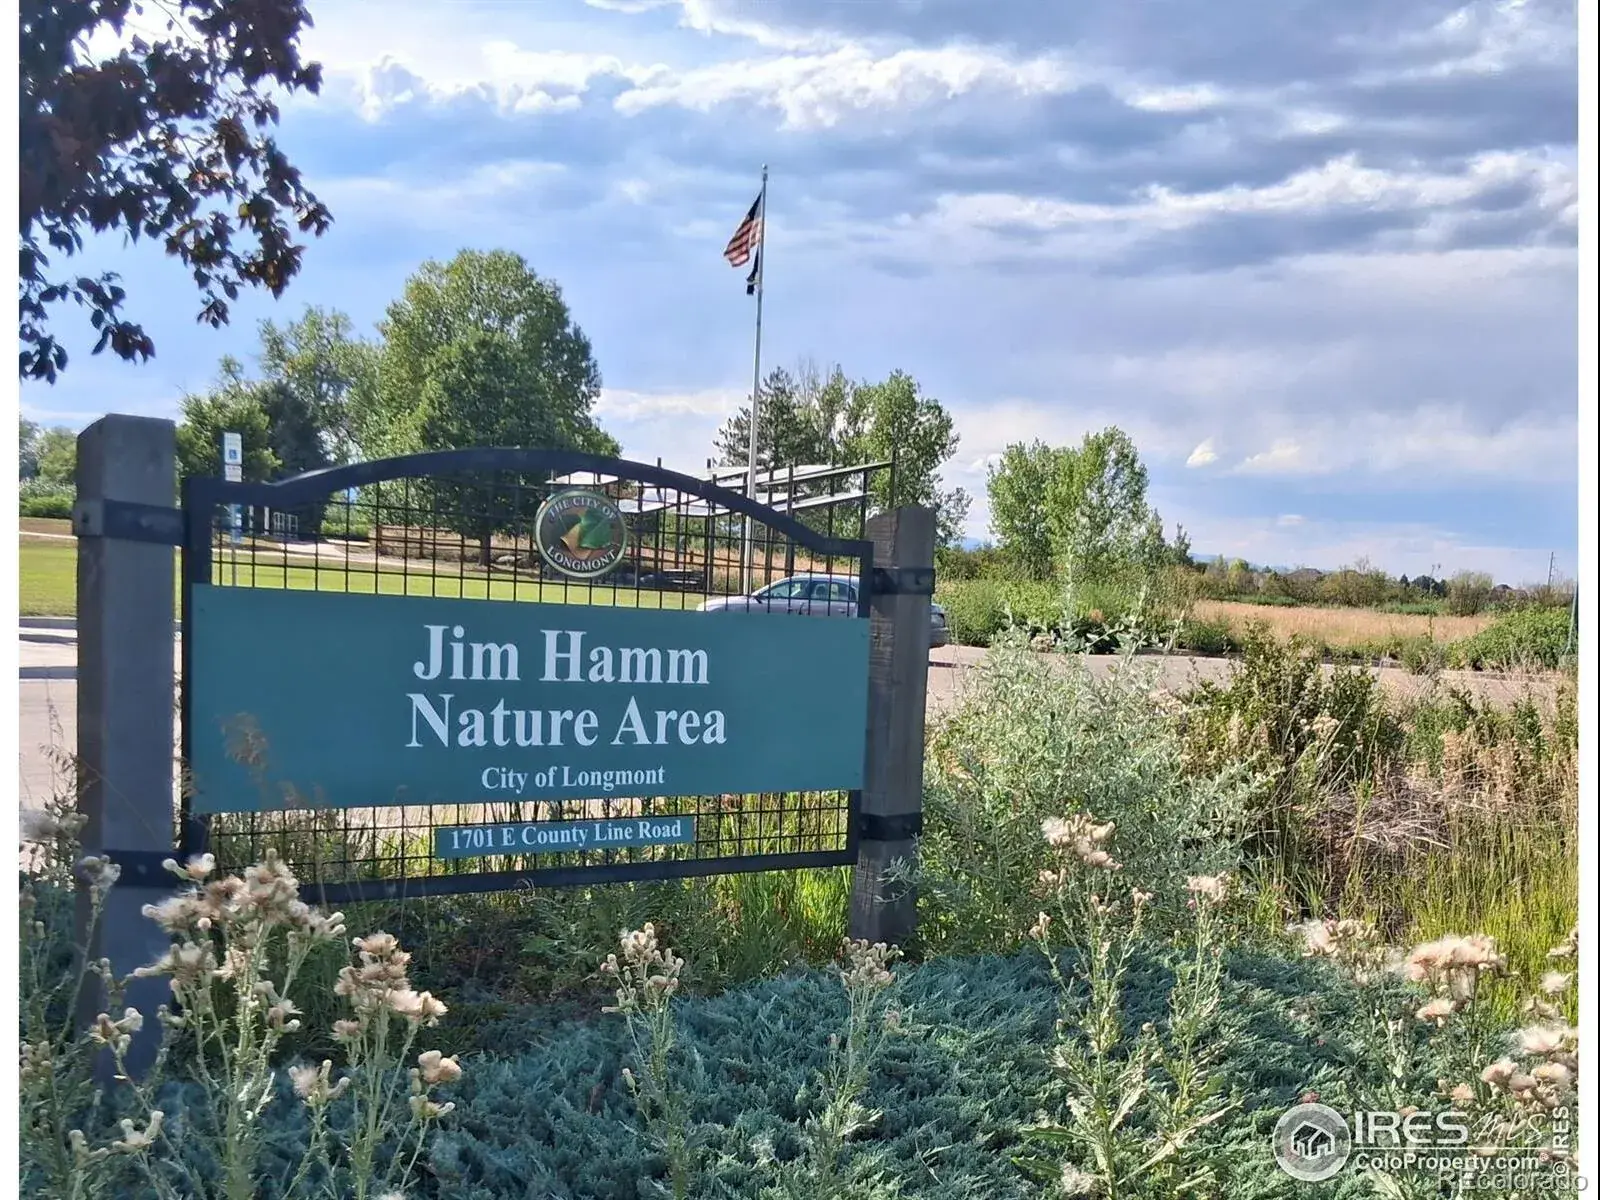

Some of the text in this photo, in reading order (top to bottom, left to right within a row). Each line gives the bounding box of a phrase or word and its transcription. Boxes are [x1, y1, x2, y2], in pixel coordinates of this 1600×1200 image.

[549, 496, 617, 520] THE CITY OF
[546, 545, 616, 571] LONGMONT
[413, 624, 710, 685] Jim Hamm
[404, 692, 727, 748] Nature Area
[481, 765, 666, 794] City of Longmont
[450, 819, 682, 849] 1701 E County Line Road
